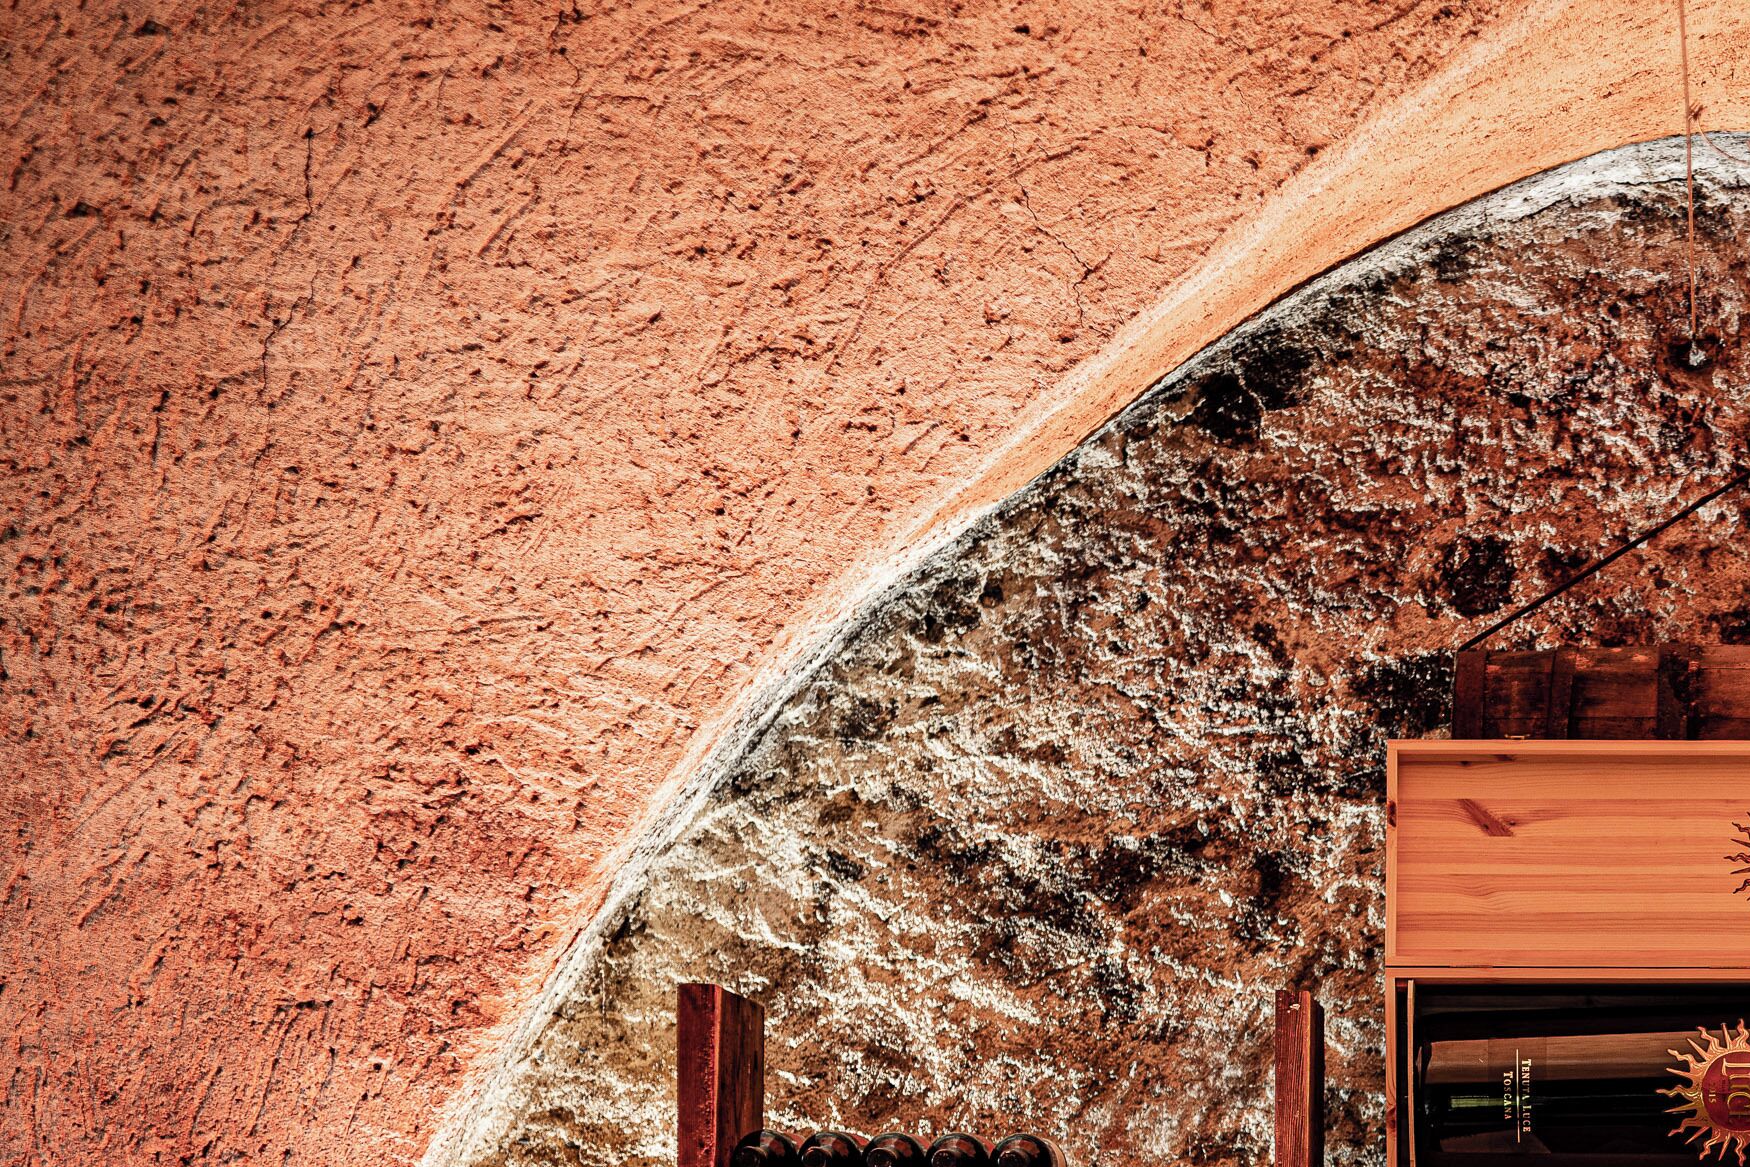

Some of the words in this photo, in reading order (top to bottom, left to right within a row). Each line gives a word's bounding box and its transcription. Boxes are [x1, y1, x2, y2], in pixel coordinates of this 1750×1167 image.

[1503, 1071, 1514, 1120] TOSCANA
[1521, 1059, 1532, 1100] TENUTA
[1522, 1105, 1532, 1132] LUCE
